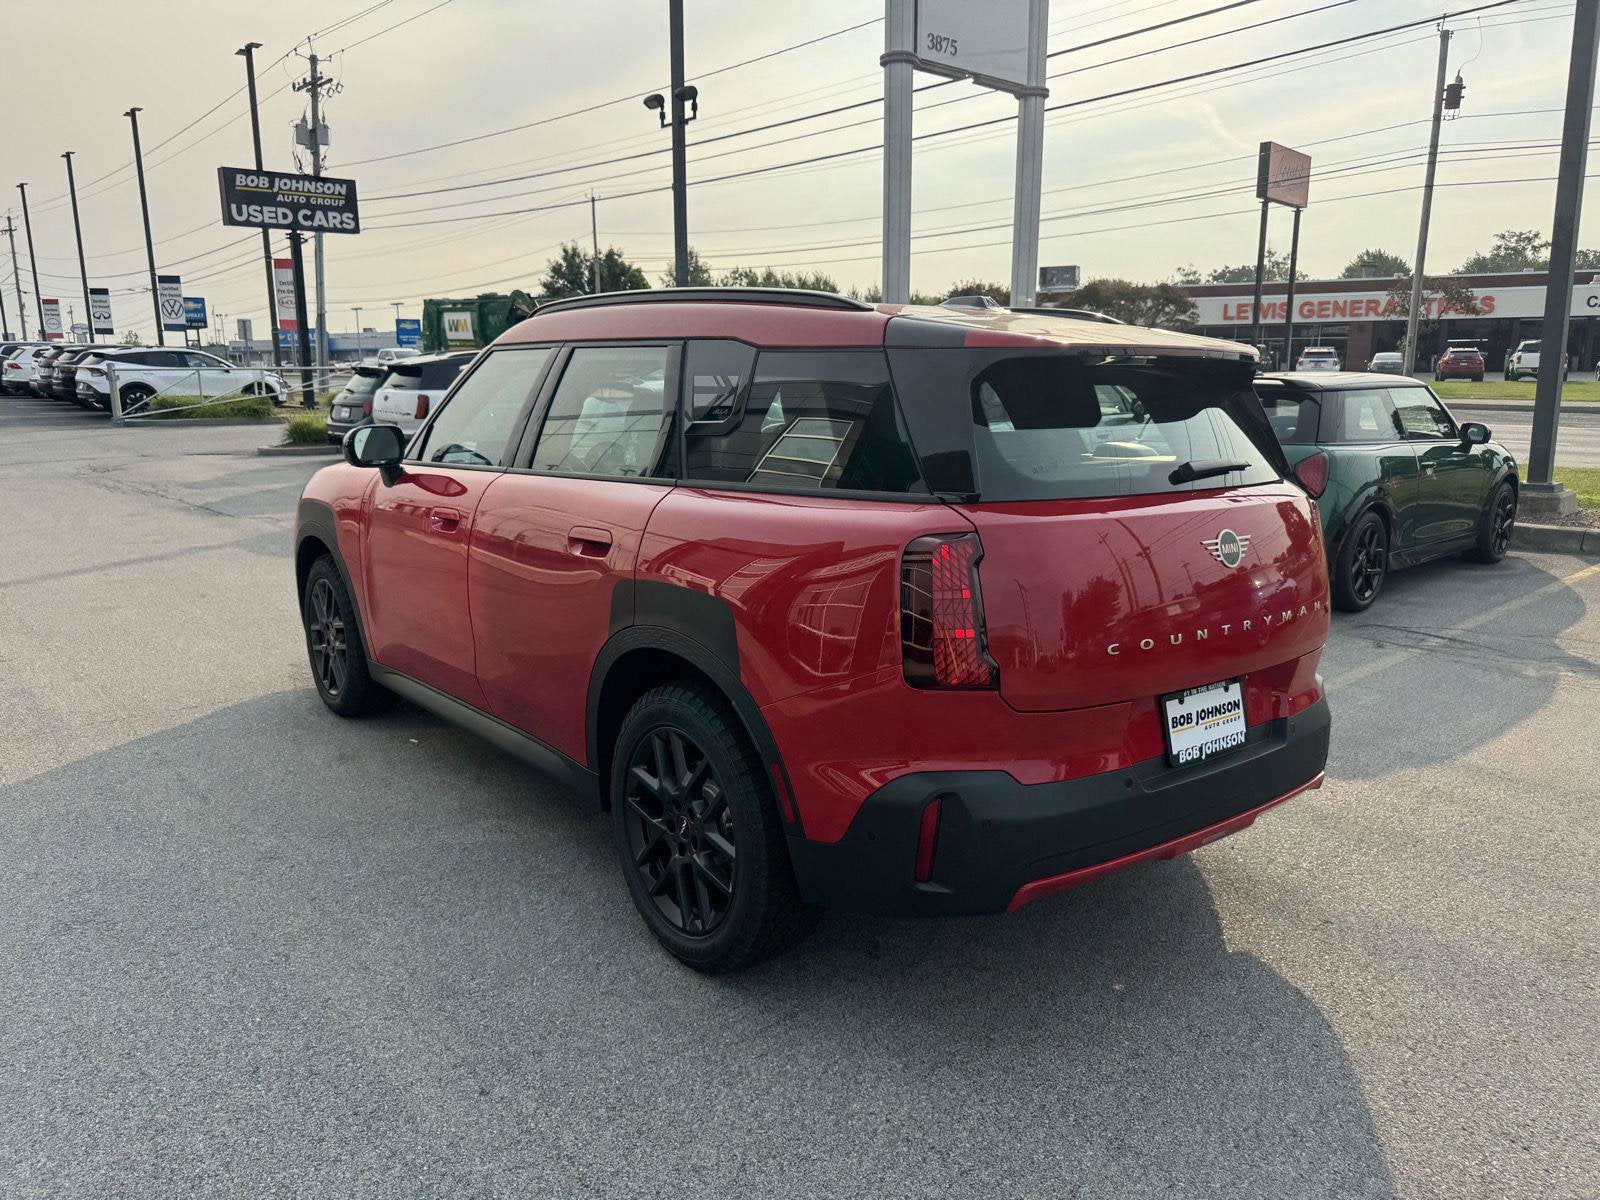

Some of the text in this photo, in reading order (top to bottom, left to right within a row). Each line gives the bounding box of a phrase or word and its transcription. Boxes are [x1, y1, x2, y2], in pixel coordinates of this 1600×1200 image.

[927, 32, 958, 56] 3875
[235, 173, 347, 195] BOB JOHNSON
[276, 194, 346, 207] AUTO GROUP
[230, 203, 356, 229] USED CARS
[1299, 298, 1408, 319] GENERA
[1426, 295, 1496, 316] TIS
[448, 318, 469, 332] WM
[1221, 542, 1239, 554] MINI
[1107, 600, 1321, 656] COUNTRYMAN
[1171, 698, 1241, 729] BOB JOHNSON
[1205, 715, 1241, 730] AUTO GROUP
[1180, 730, 1246, 763] BOB JOHNSON
